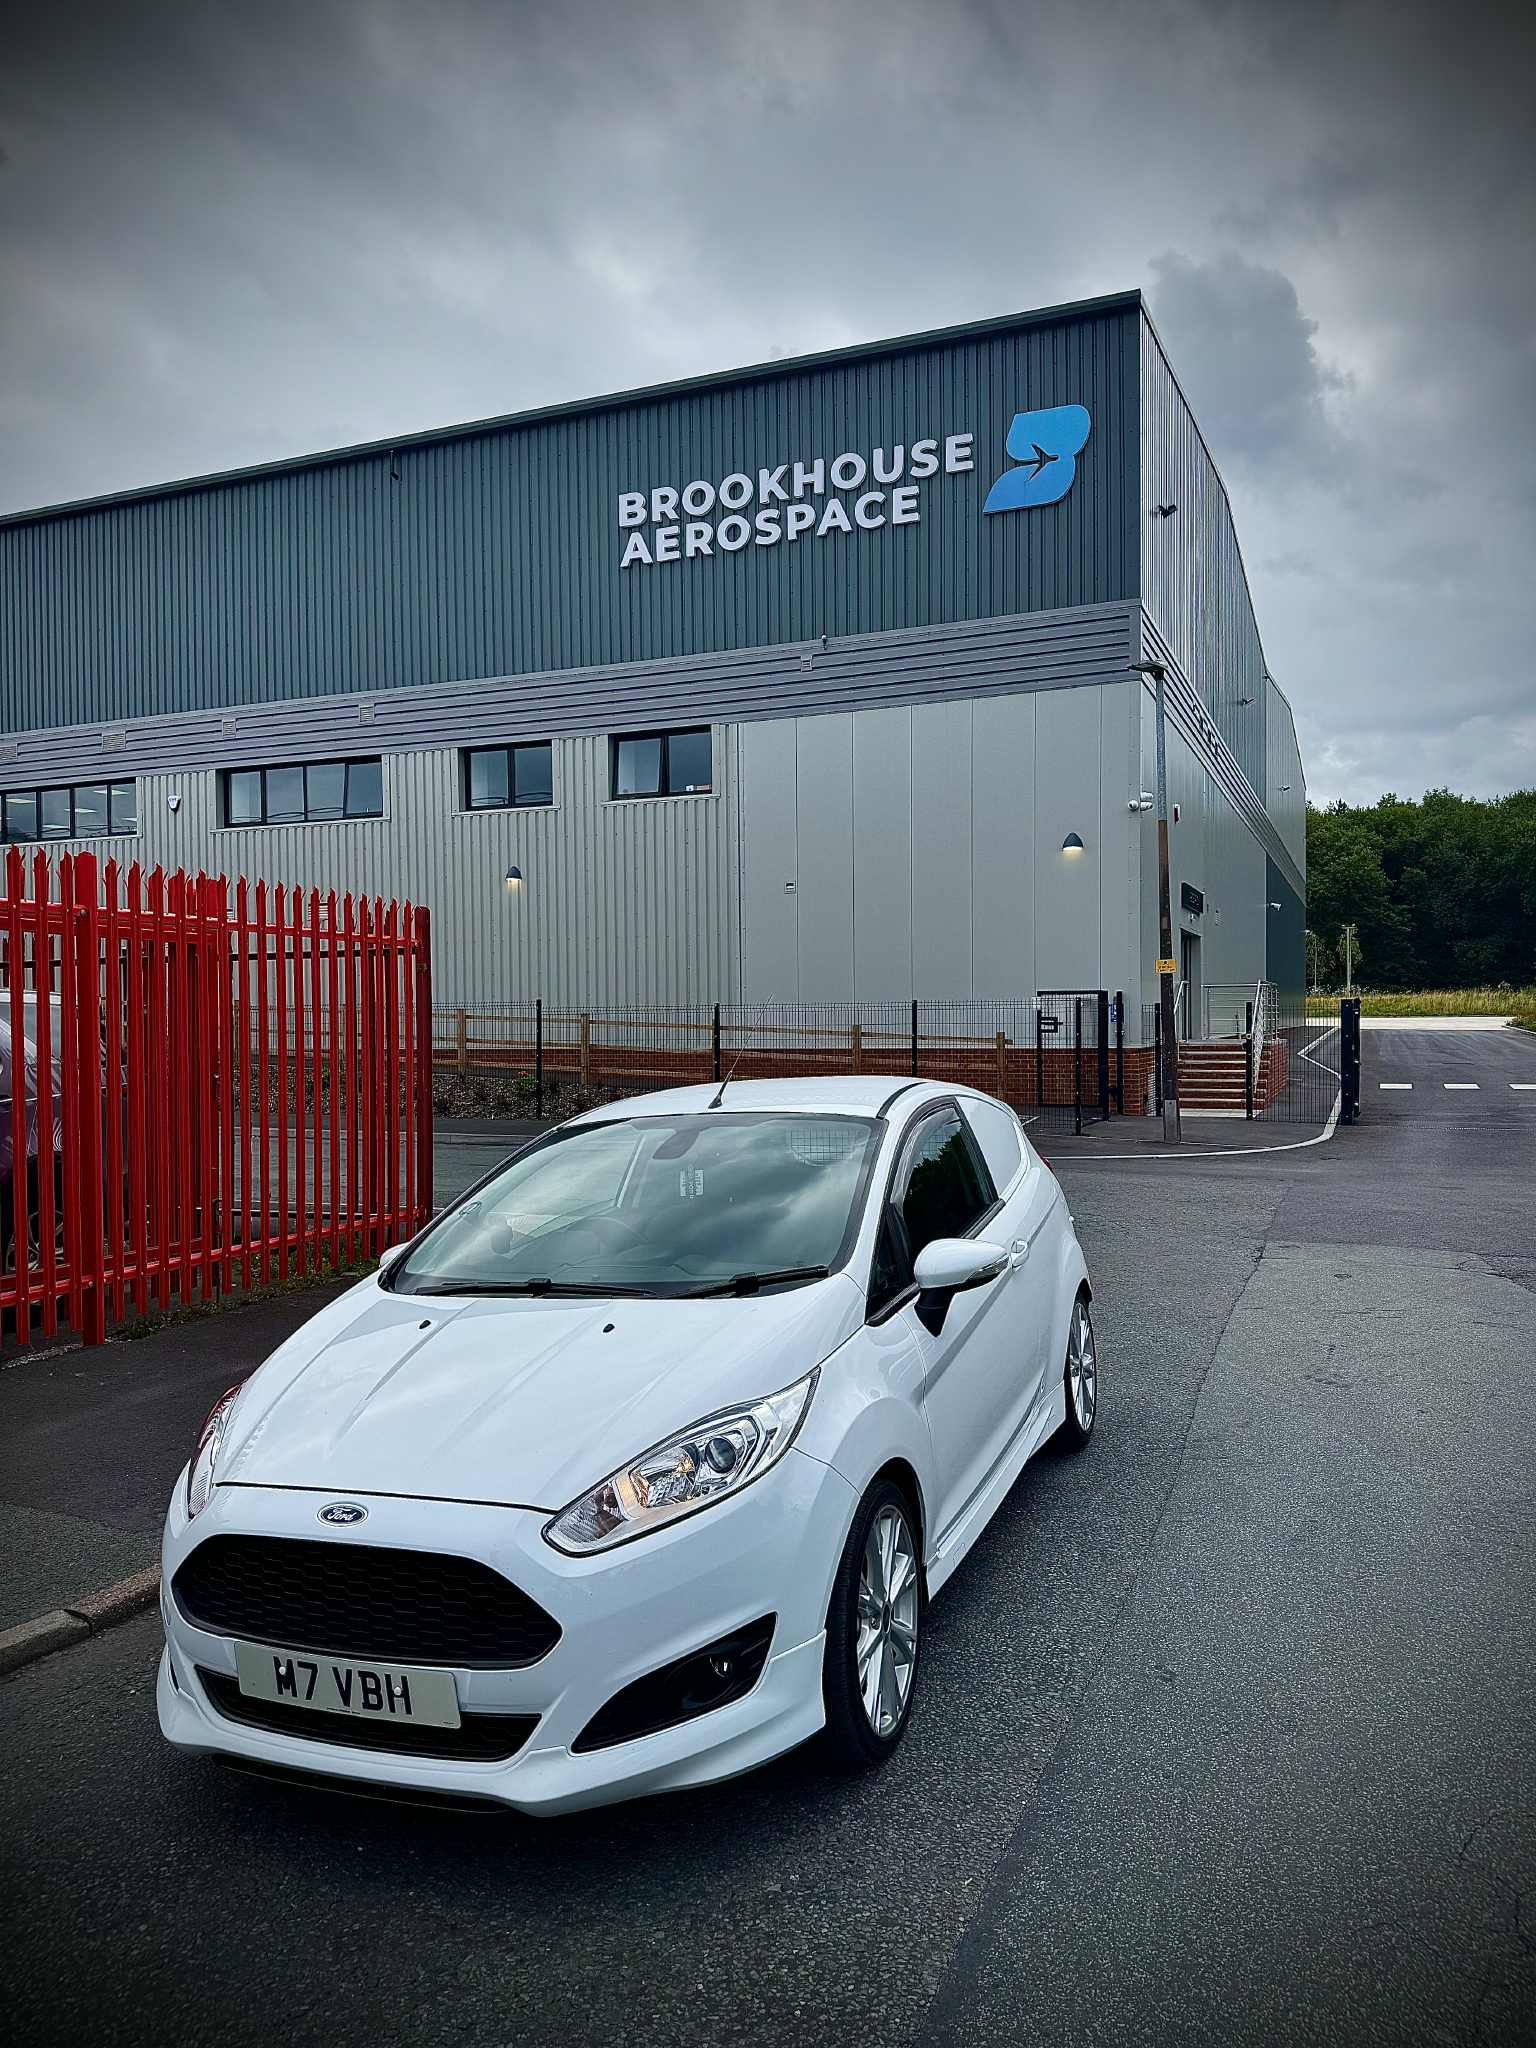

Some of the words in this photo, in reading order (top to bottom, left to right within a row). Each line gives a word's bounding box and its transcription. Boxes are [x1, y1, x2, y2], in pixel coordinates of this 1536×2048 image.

[618, 433, 974, 527] BROOKHOUSE
[620, 486, 920, 567] AEROSPACE
[327, 1507, 357, 1521] Ford
[273, 1656, 318, 1700] M7
[332, 1667, 412, 1715] VBH
